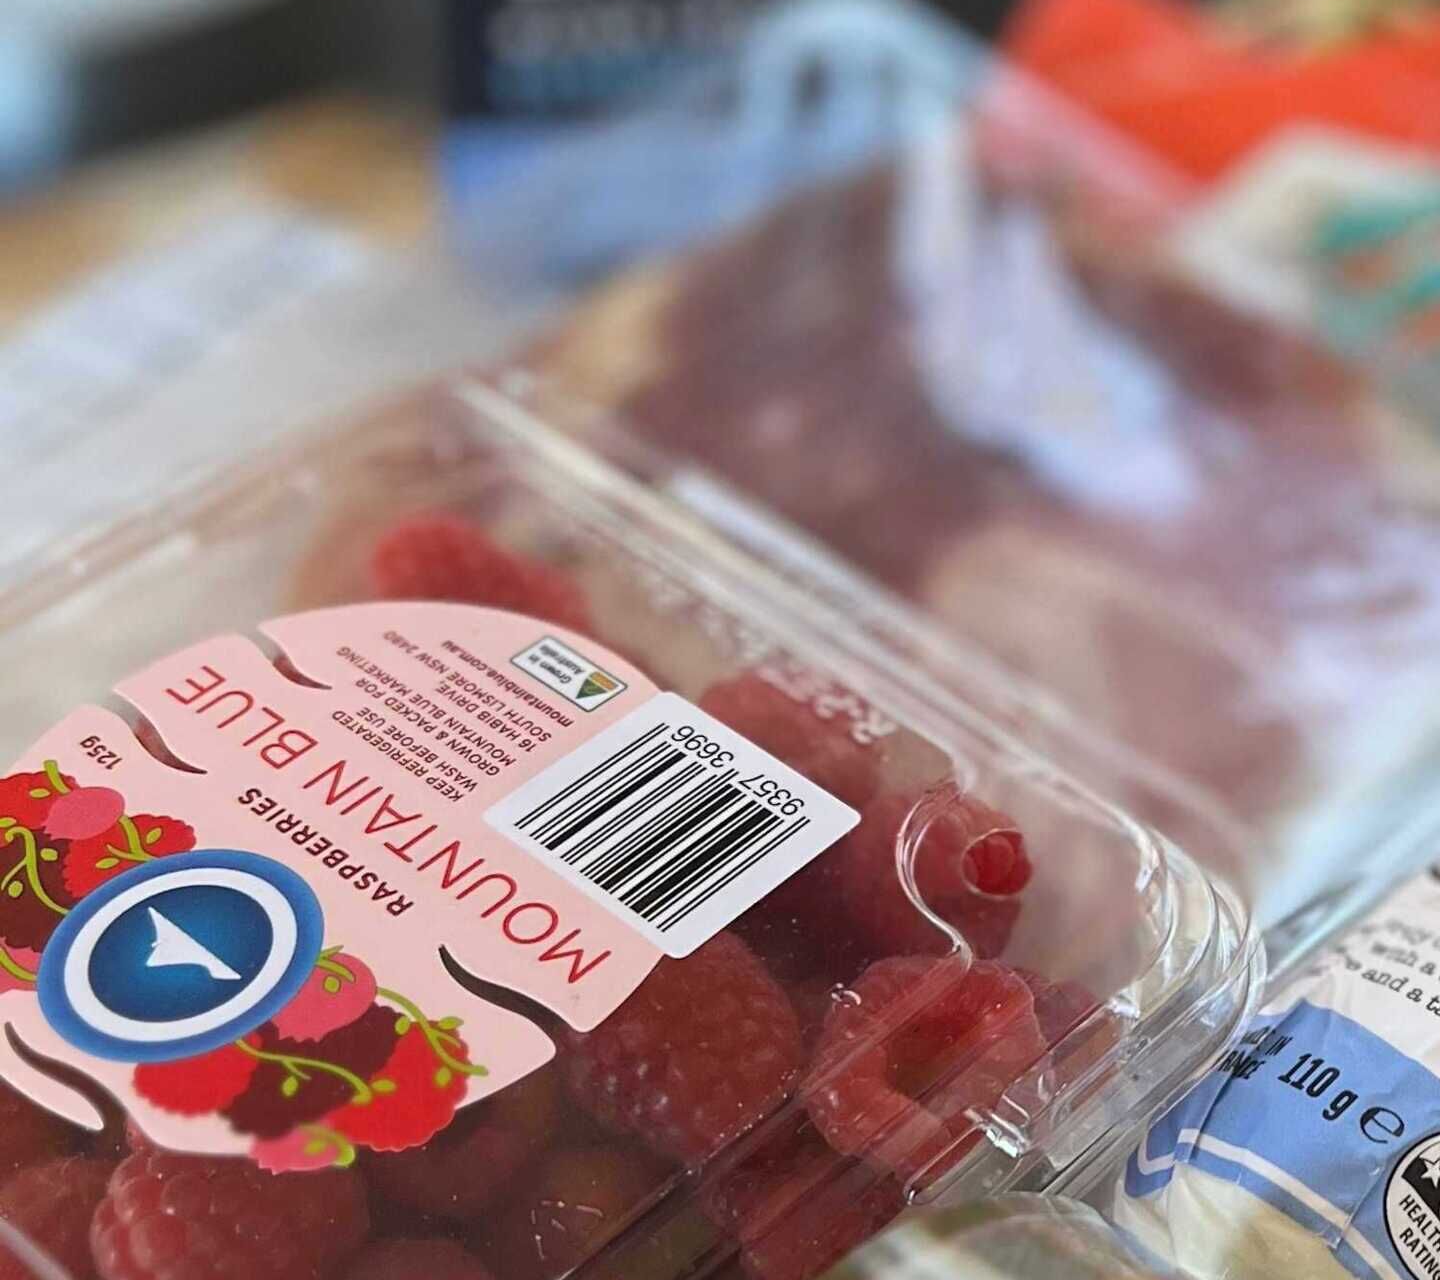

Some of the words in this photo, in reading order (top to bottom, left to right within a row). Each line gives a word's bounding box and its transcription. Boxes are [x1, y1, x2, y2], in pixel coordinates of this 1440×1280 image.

[335, 643, 413, 698] MARKETING
[415, 649, 450, 675] NSW
[537, 643, 585, 678] Australia
[538, 660, 572, 684] Grown
[354, 675, 386, 699] FOR
[434, 679, 481, 713] DRIVE,
[440, 635, 574, 731] mountainblue.com.au
[448, 670, 506, 712] LISMORE
[164, 660, 318, 772] BLUE
[356, 705, 386, 728] USE
[383, 694, 437, 733] PACKED
[409, 693, 446, 720] BLUE
[504, 707, 552, 742] SOUTH
[330, 708, 429, 778] REFRIGERATED
[384, 724, 438, 763] BEFORE
[435, 730, 449, 741] &
[444, 715, 516, 767] MOUNTAIN
[477, 709, 521, 742] HABIB
[76, 733, 124, 770] 125g
[446, 737, 501, 776] GROWN
[518, 737, 536, 752] 16
[669, 720, 736, 772] 3696
[425, 773, 464, 802] KEEP
[436, 760, 478, 791] WASH
[737, 766, 806, 819] 9357
[234, 786, 415, 916] RASPBERRIES
[297, 757, 614, 982] MOUNTAIN
[1361, 967, 1409, 994] and
[1406, 986, 1423, 1003] a
[1277, 1052, 1341, 1099] 110
[1321, 1089, 1359, 1122] g
